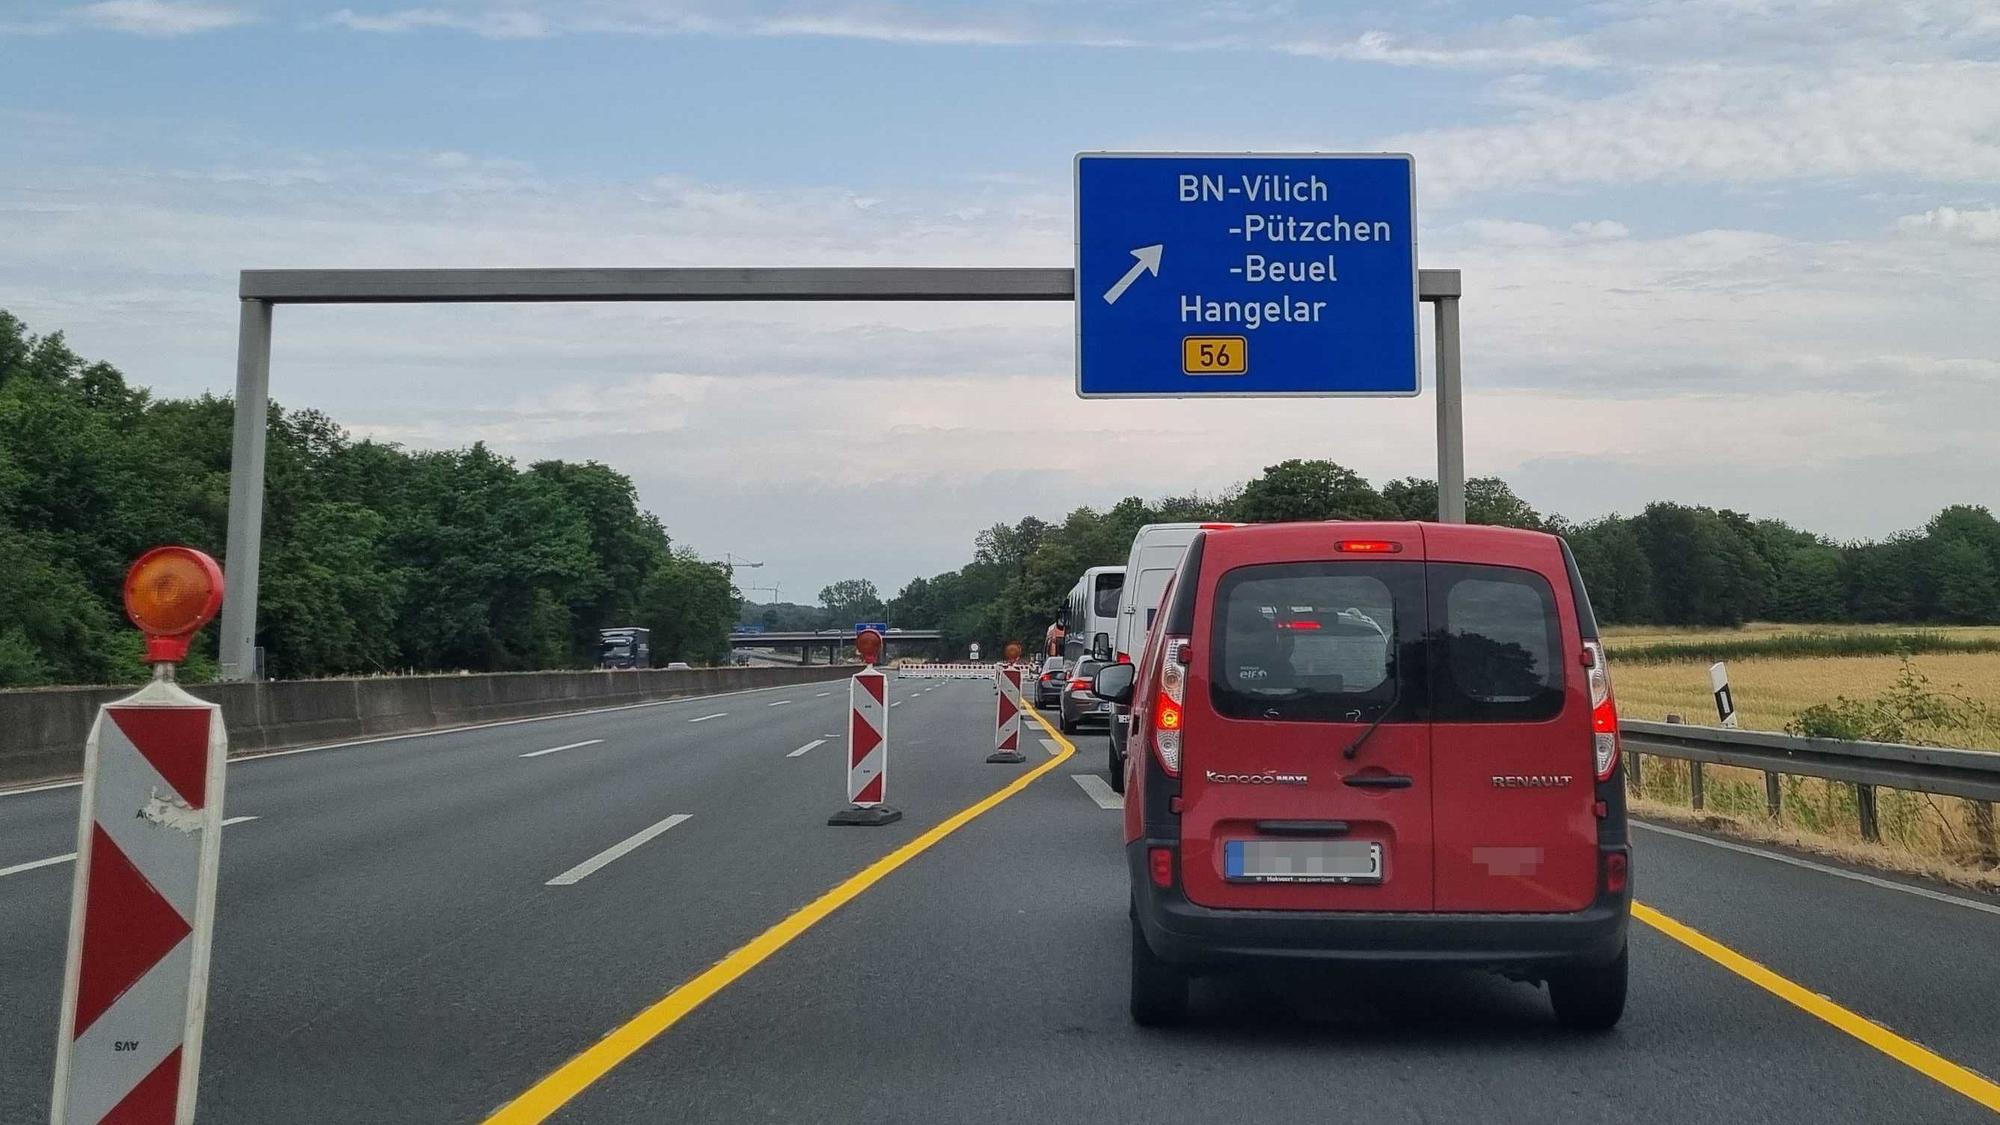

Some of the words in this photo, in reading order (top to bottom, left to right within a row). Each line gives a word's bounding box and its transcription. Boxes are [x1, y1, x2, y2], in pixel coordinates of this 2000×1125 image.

[1179, 174, 1328, 202] BN-Vilich
[1229, 214, 1391, 242] -Pützchen
[1229, 255, 1338, 282] -Beuel
[1181, 295, 1327, 330] Hangelar
[1199, 344, 1230, 367] 56
[1491, 775, 1573, 787] RENAULT
[114, 1041, 140, 1051] AVS
